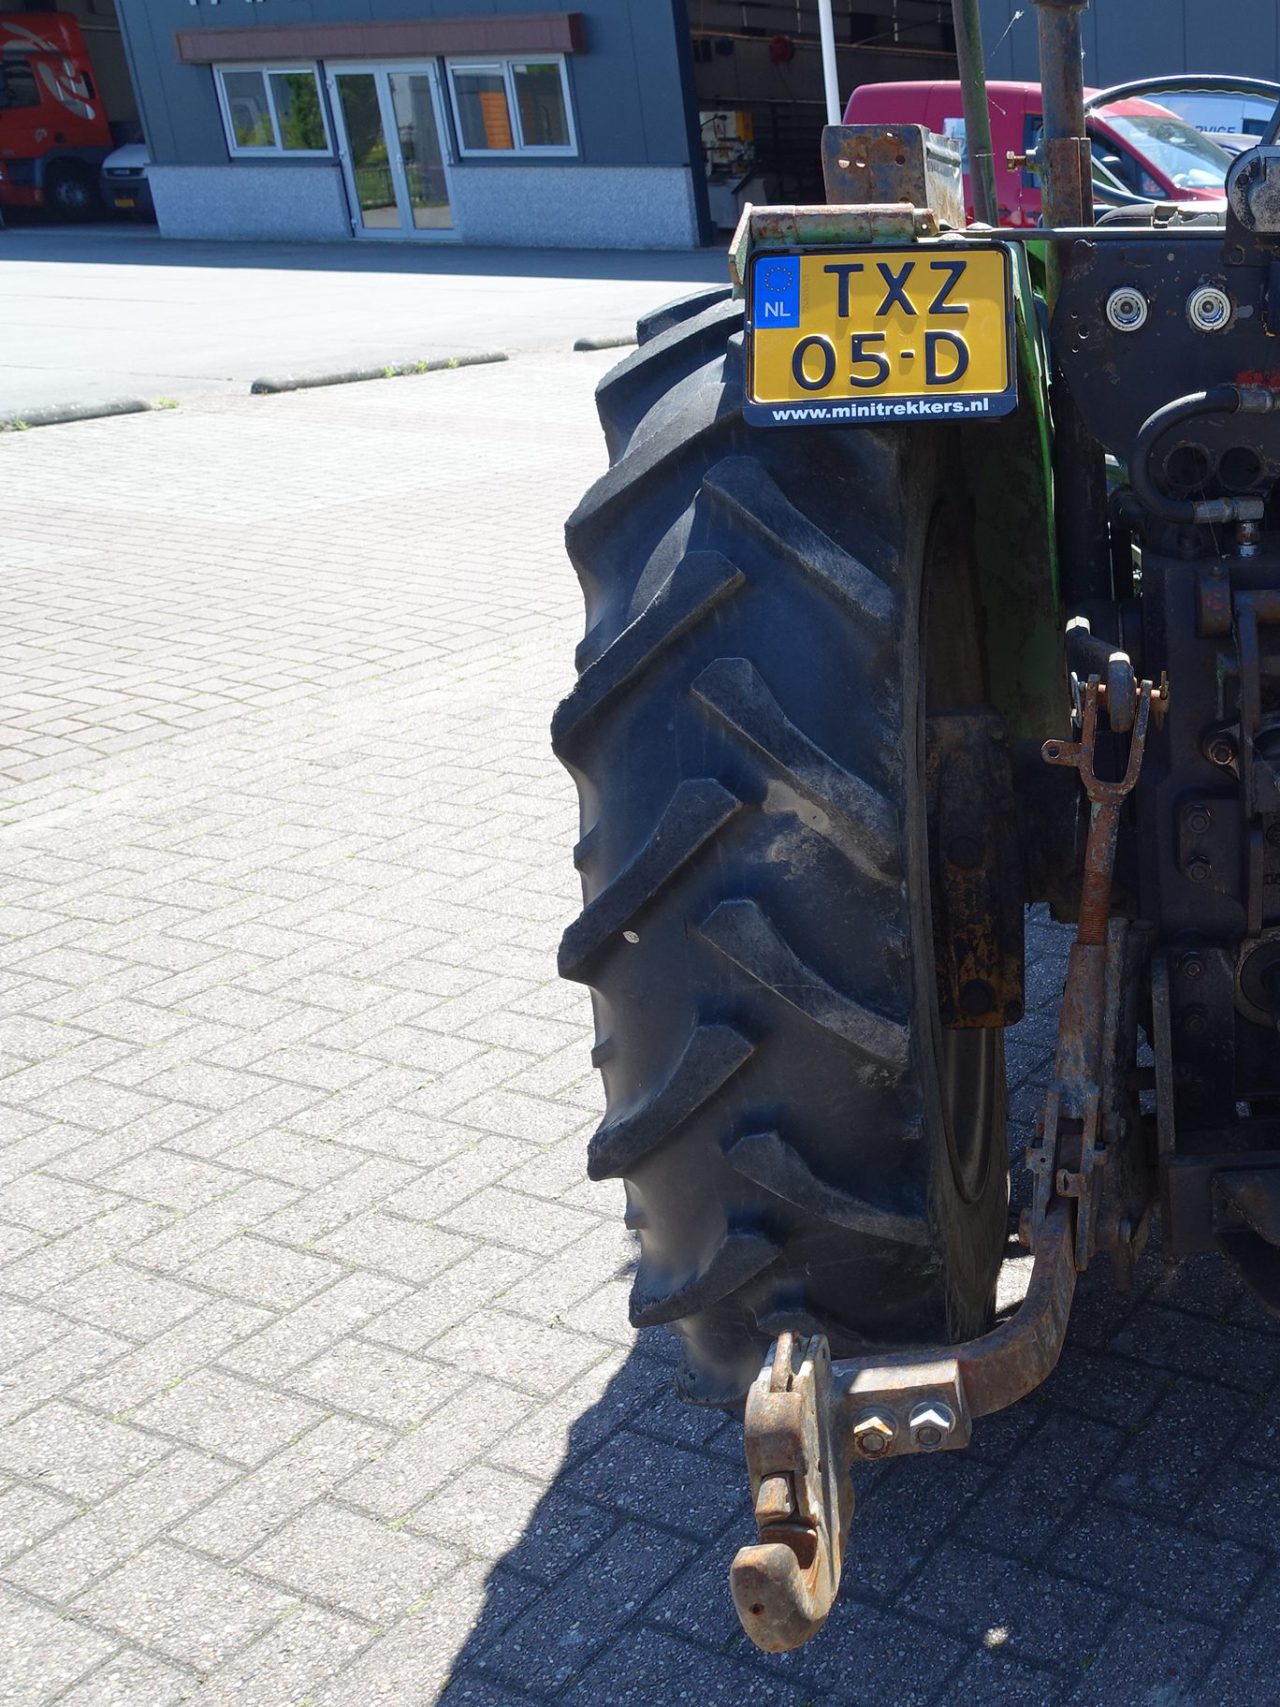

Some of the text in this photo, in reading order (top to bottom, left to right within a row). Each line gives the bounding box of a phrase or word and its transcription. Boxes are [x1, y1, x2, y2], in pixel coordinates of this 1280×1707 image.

[823, 260, 970, 318] TXZ
[764, 302, 792, 318] NL
[791, 329, 971, 391] 05-D
[772, 397, 990, 421] www.minitrekkers.nl
